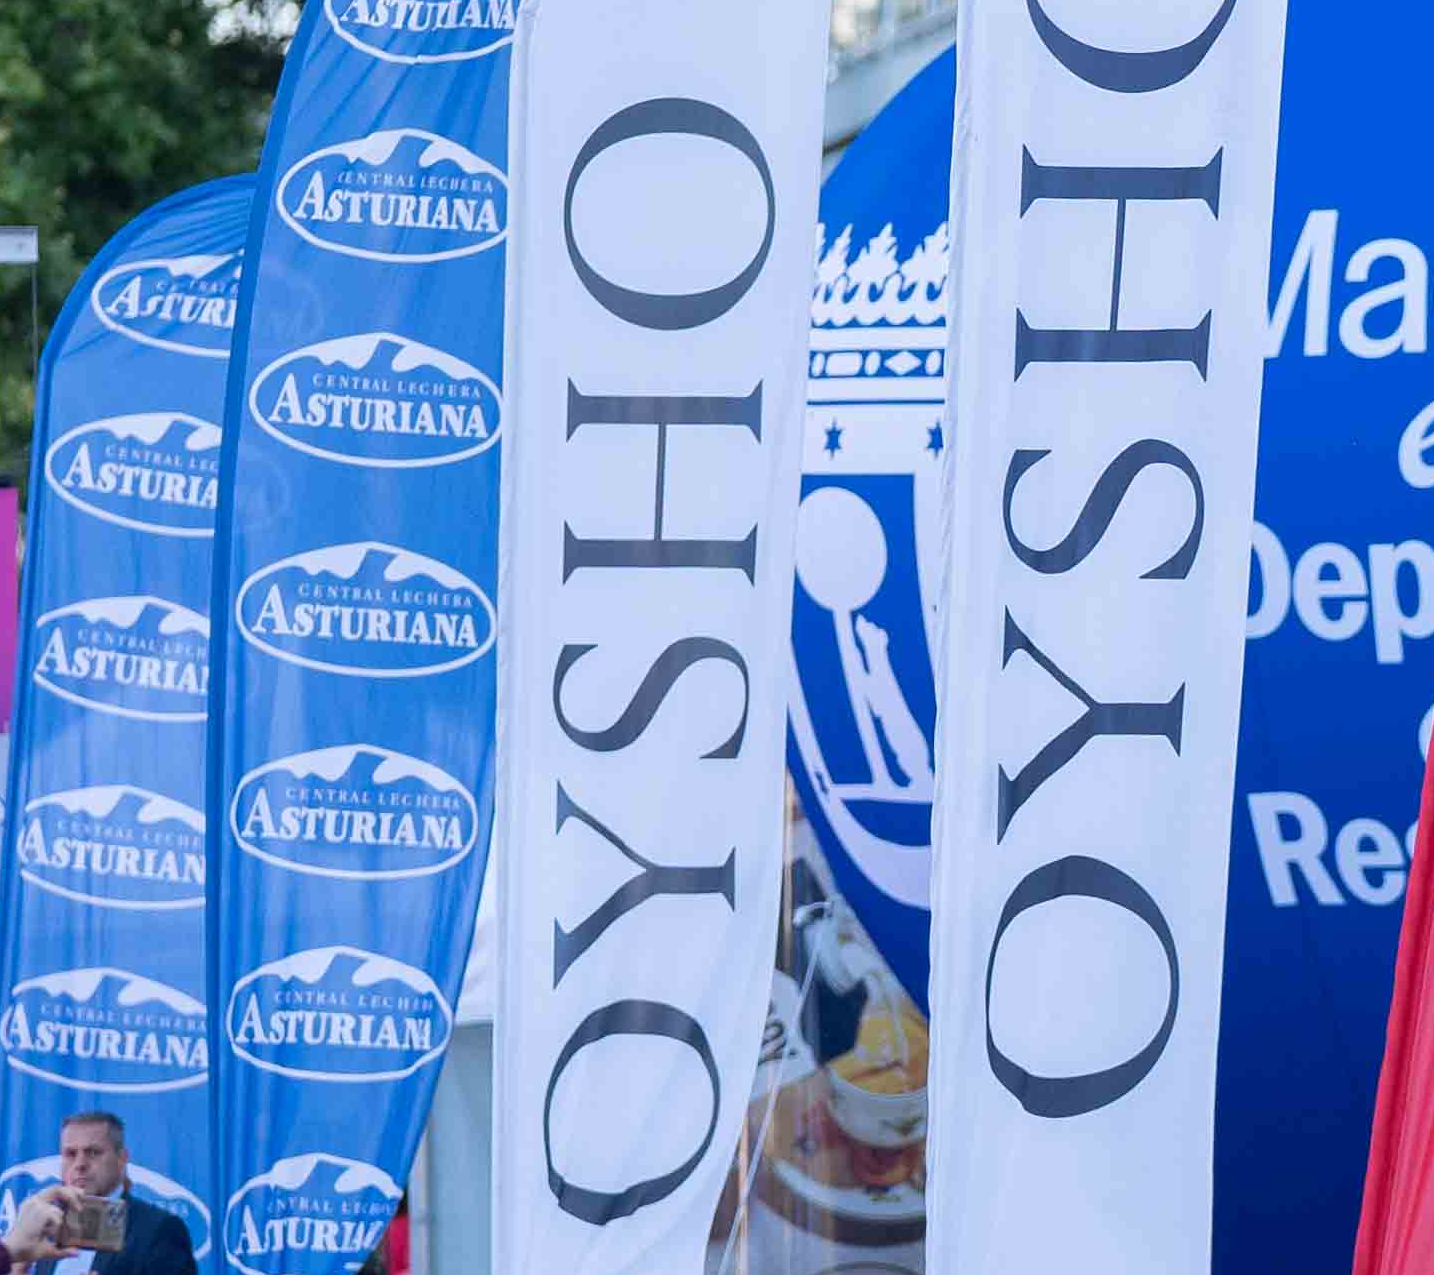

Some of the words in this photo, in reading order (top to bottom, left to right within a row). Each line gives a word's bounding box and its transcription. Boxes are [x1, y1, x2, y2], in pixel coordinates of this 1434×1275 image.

[294, 170, 500, 233] ASTURIANA
[268, 372, 488, 439] ASTURIANA
[312, 373, 391, 392] CENTRAL
[397, 381, 482, 399] LECHERA
[252, 582, 479, 648] ASTURIANA
[298, 582, 384, 603] CENTRAL
[391, 589, 473, 608] LECHERA
[543, 97, 776, 1227] OYSHO
[241, 787, 463, 849] ASTURIANA
[286, 788, 372, 805] CENTRAL
[1247, 791, 1419, 908] Re
[6, 1003, 209, 1068] ASTURIANA
